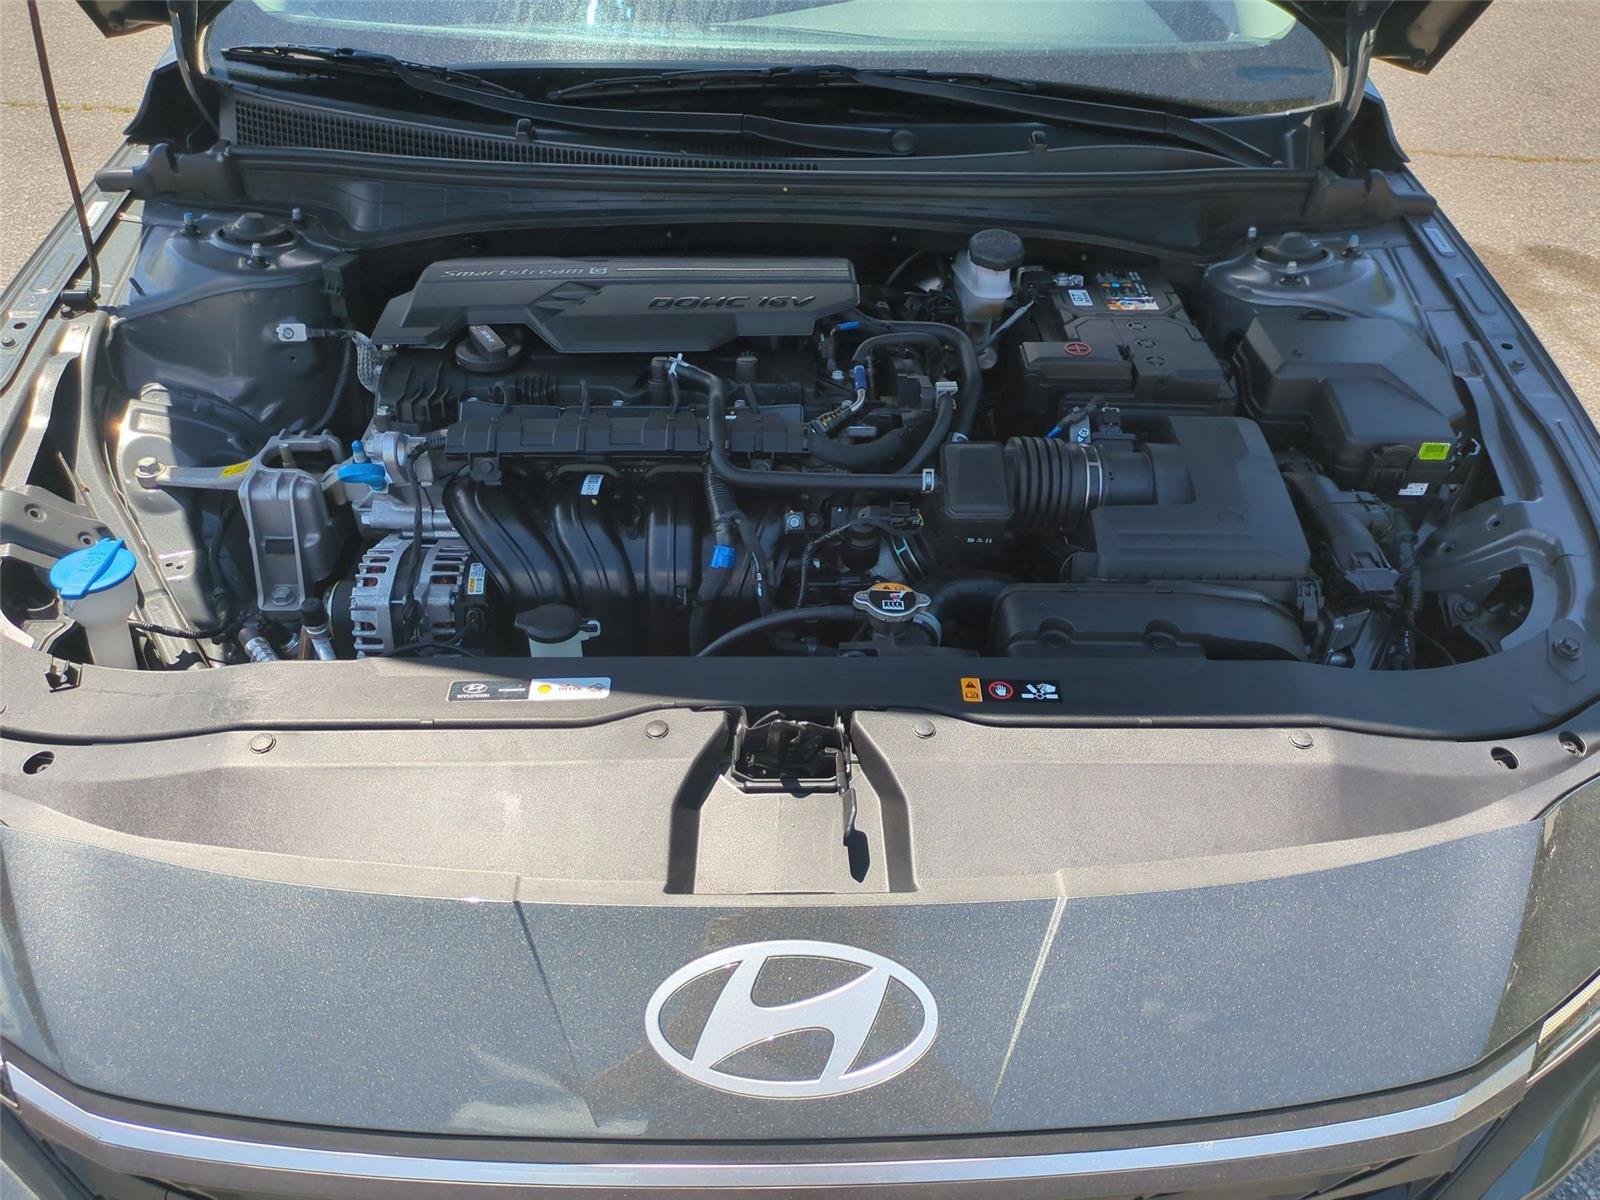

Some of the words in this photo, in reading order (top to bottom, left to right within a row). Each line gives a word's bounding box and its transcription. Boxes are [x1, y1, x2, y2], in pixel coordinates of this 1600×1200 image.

[440, 267, 585, 278] Smartstream
[648, 296, 750, 309] DOHC
[758, 295, 817, 308] 16V
